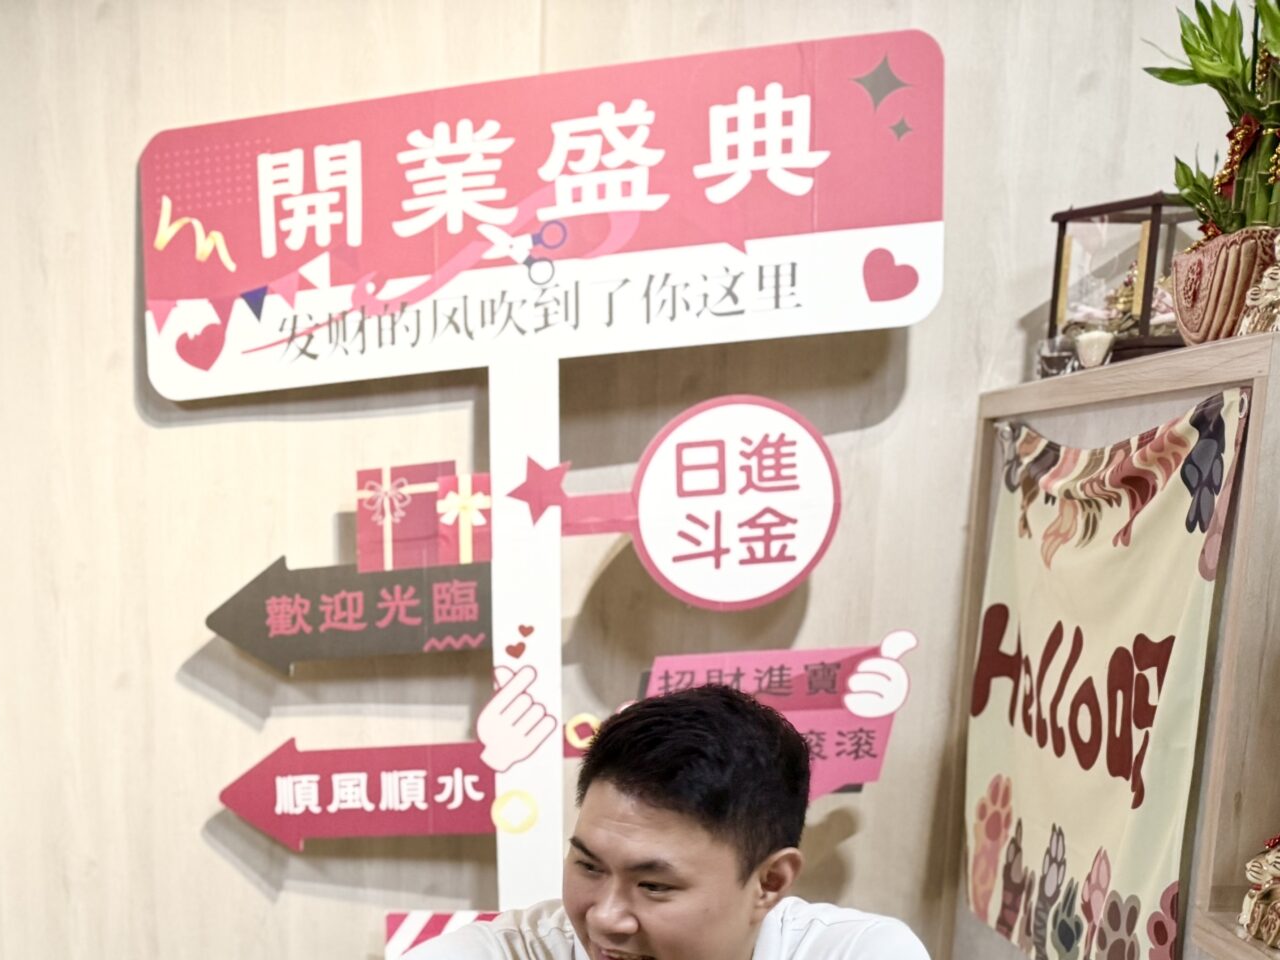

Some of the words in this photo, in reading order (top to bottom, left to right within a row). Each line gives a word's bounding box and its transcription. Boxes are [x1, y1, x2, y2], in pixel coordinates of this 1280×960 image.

[257, 81, 831, 259] 開業盛典
[278, 261, 804, 363] 发财的风吹到了你这里
[675, 432, 800, 498] 日進
[672, 506, 799, 570] 斗金
[265, 579, 480, 638] 歡迎光臨
[274, 767, 485, 815] 順風順水
